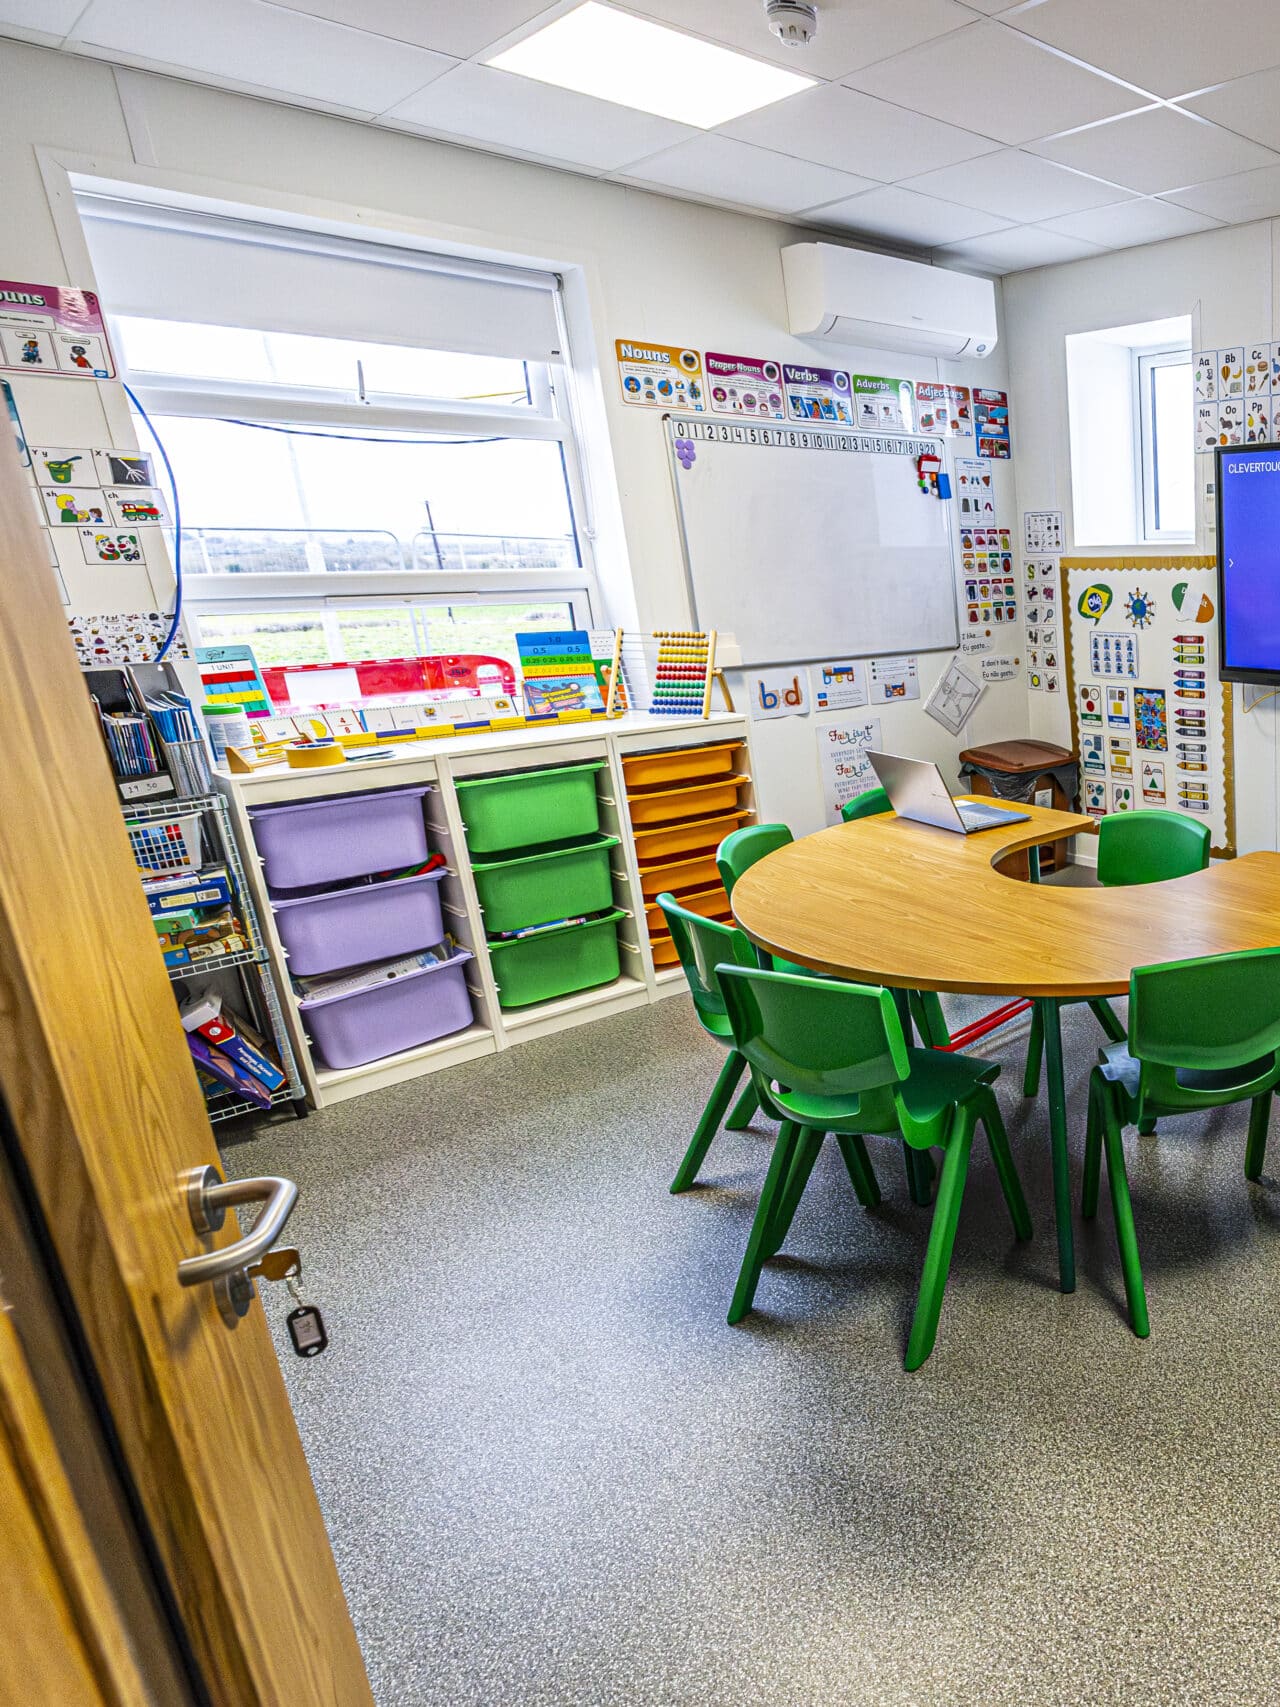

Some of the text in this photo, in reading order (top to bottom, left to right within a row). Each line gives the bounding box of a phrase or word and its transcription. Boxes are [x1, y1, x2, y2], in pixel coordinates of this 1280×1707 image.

[620, 343, 670, 363] Nouns
[1199, 357, 1210, 367] Aa
[1224, 354, 1236, 364] Bb
[1252, 350, 1262, 360] Cc
[709, 358, 761, 374] Proper Nouns
[785, 367, 819, 382] Verbs
[856, 378, 890, 391] Adverbs
[1200, 408, 1210, 418] Nn
[1225, 406, 1236, 414] Oo
[1252, 402, 1262, 414] Pp
[678, 423, 684, 436] 0
[694, 424, 698, 438] 1
[708, 426, 714, 439] 2
[722, 427, 728, 440] 3
[736, 428, 742, 441] 4
[750, 428, 756, 442] 5
[764, 430, 770, 444] 6
[776, 432, 782, 444] 7
[790, 433, 796, 446] 8
[802, 434, 808, 446] 9
[814, 436, 822, 448] 10
[826, 436, 834, 448] 11
[838, 437, 847, 450] 12
[850, 438, 858, 450] 13
[862, 439, 870, 451] 14
[872, 440, 881, 452] 15
[884, 440, 892, 452] 16
[894, 441, 902, 454] 17
[906, 442, 914, 454] 18
[567, 646, 580, 654] 0.5
[962, 644, 970, 652] Eu
[986, 659, 1000, 667] don't
[828, 730, 857, 745] Fair
